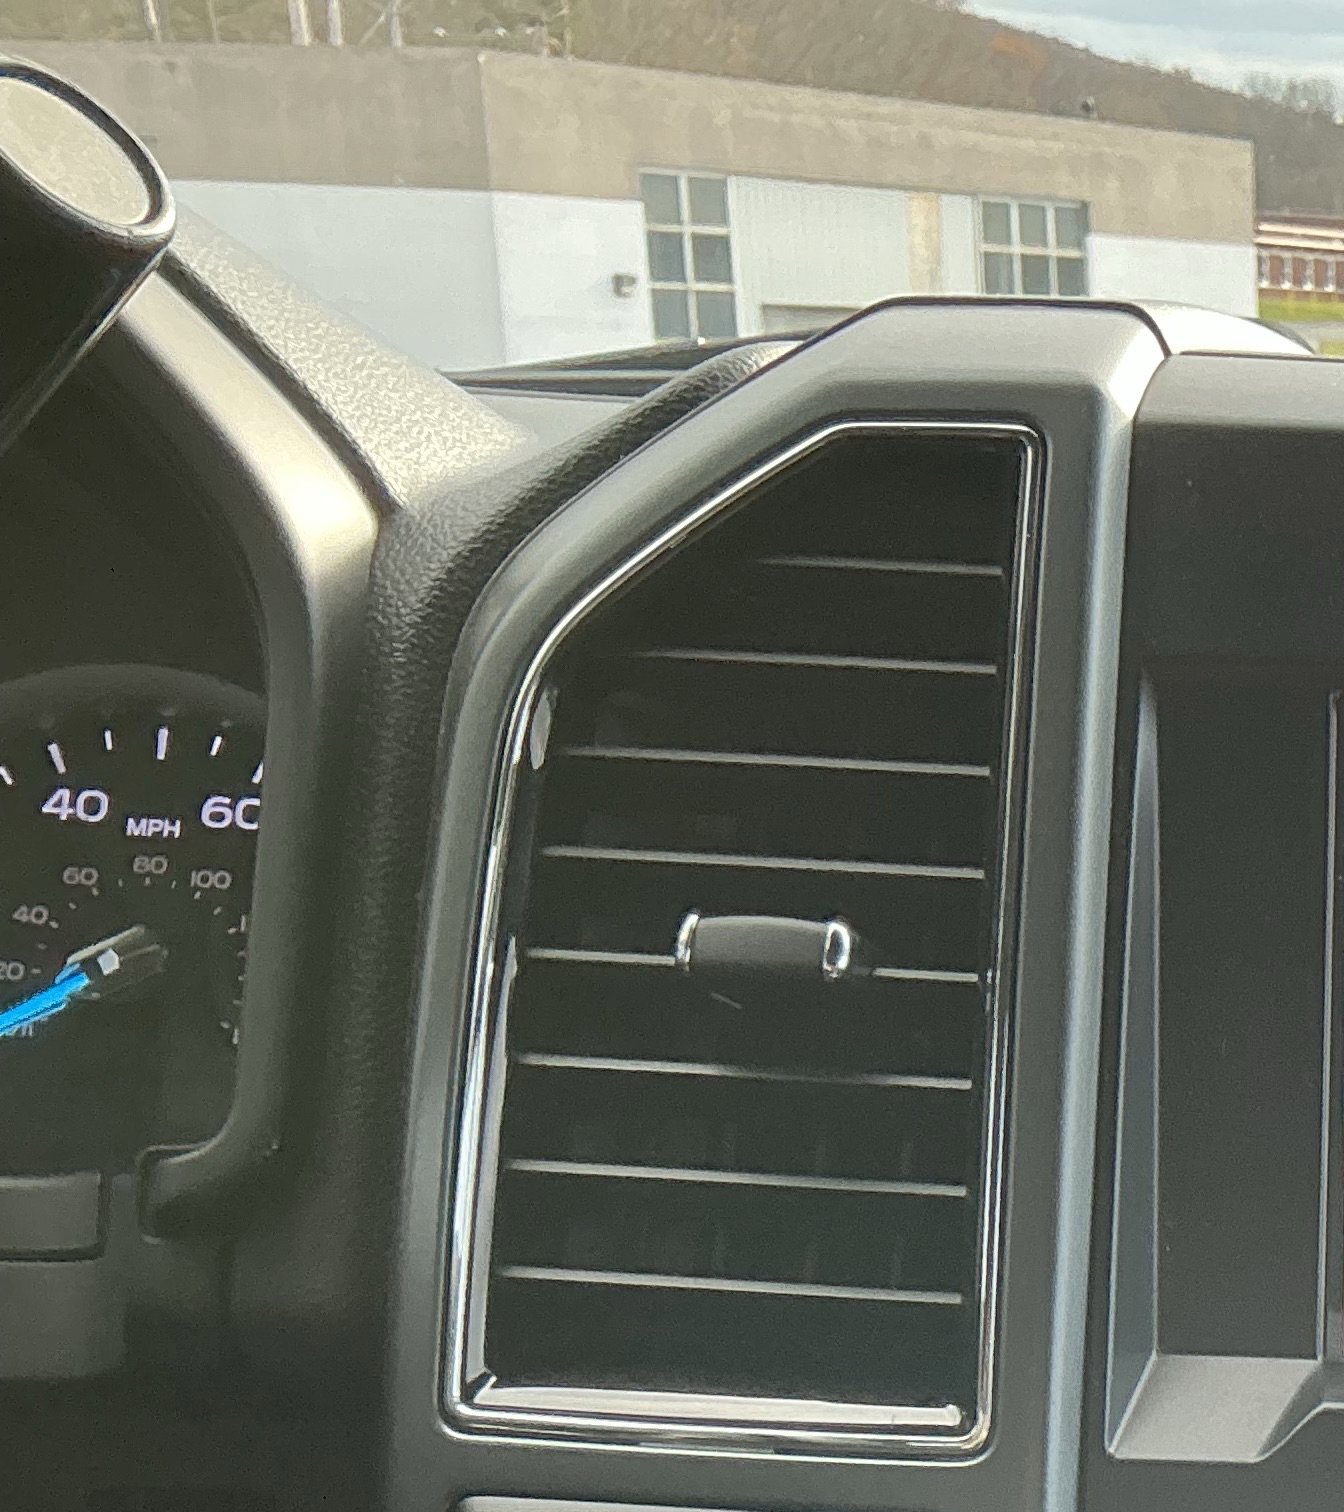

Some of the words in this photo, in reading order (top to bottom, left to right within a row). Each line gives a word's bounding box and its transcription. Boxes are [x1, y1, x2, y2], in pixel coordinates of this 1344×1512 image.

[41, 787, 110, 823] 40
[126, 818, 181, 838] MPH
[133, 854, 168, 875] 80
[62, 867, 98, 886] 60
[191, 870, 232, 890] 100
[12, 905, 50, 925] 40
